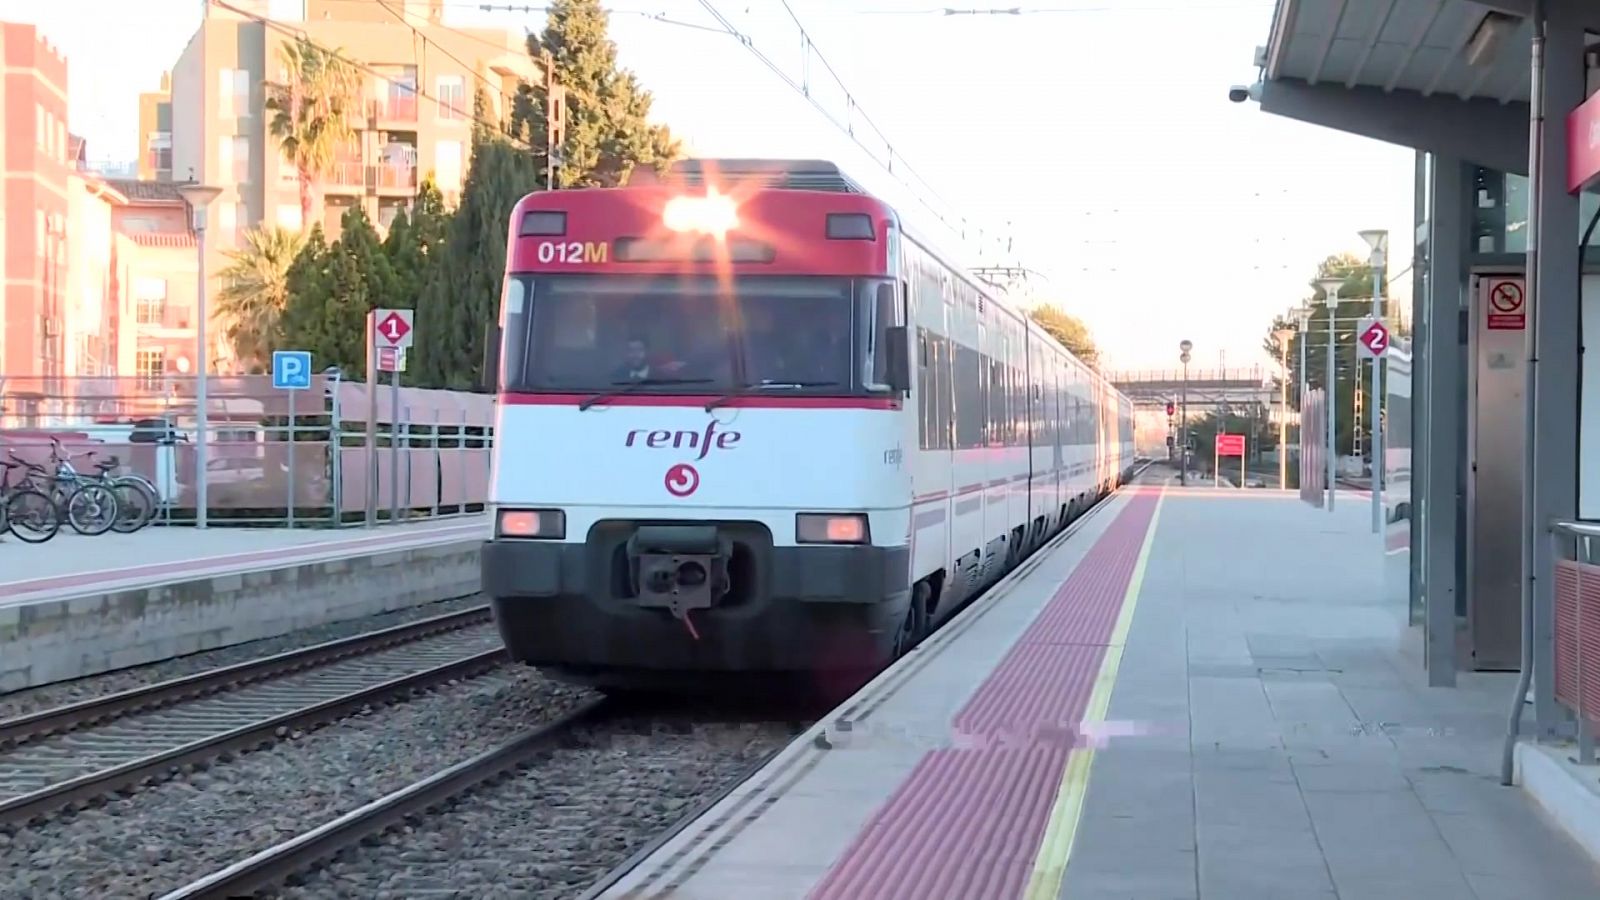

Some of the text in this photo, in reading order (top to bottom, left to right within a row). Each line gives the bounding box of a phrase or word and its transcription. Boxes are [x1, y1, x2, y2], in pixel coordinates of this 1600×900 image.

[538, 241, 608, 263] 012M
[386, 319, 401, 338] 1
[1370, 328, 1385, 349] 2
[281, 356, 302, 383] P
[624, 419, 741, 461] renfe
